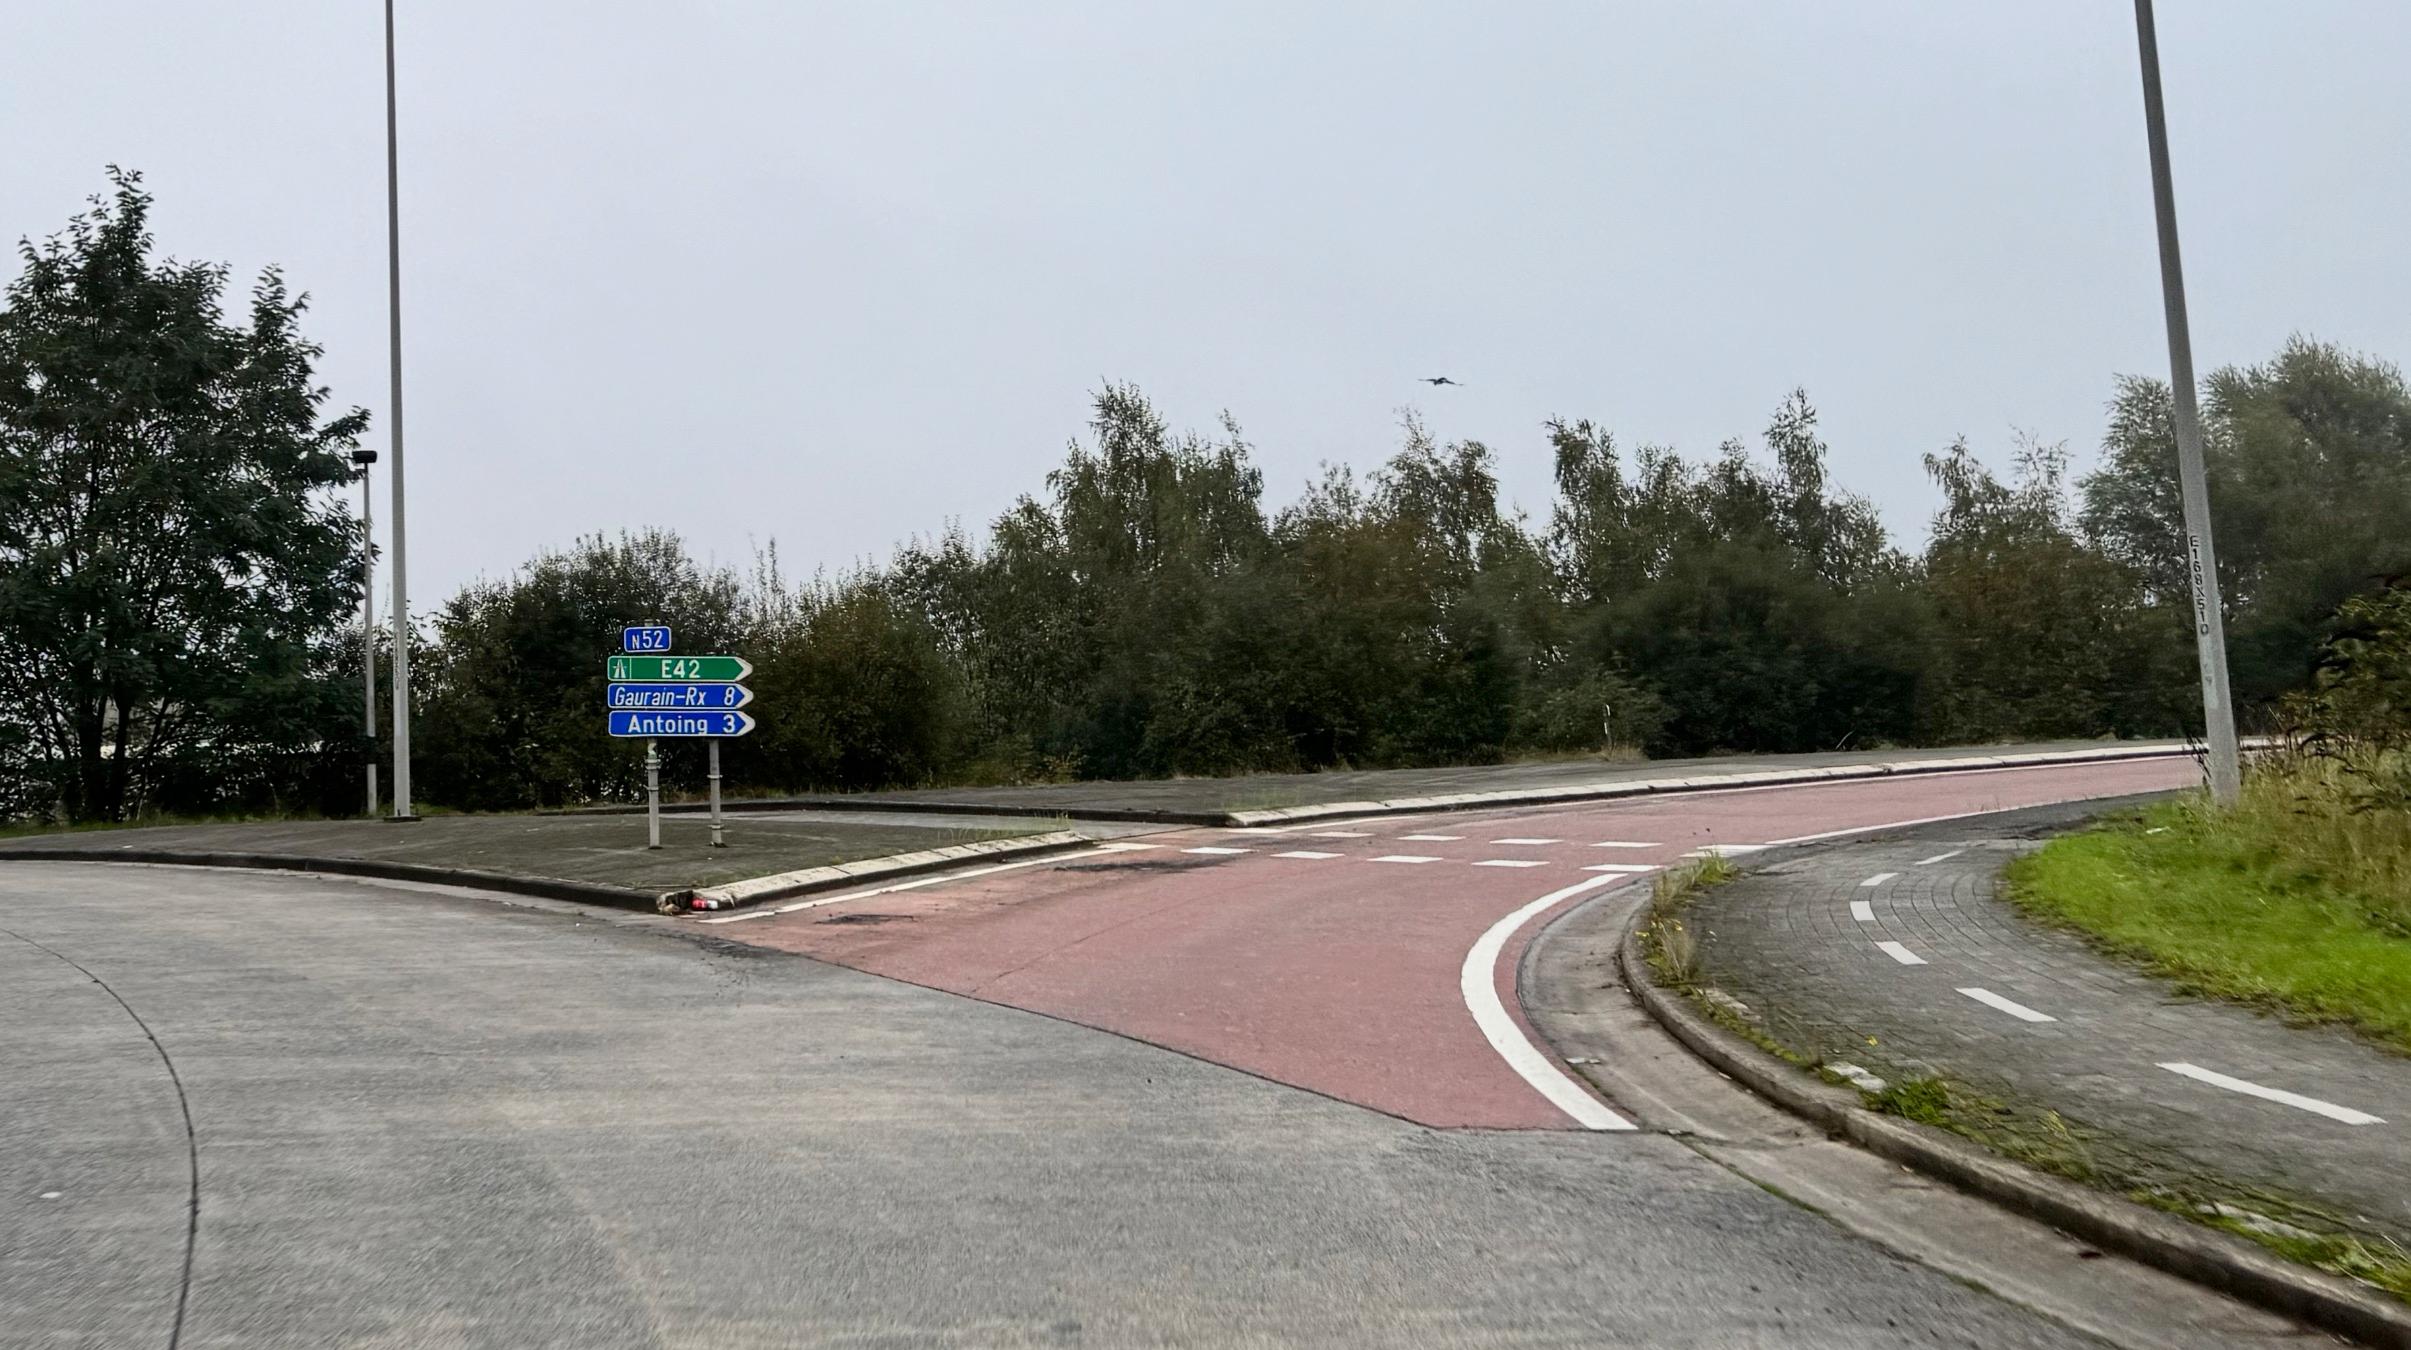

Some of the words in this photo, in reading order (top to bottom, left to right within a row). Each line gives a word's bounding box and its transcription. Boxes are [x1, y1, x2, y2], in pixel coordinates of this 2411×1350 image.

[632, 630, 664, 650] N52
[661, 659, 701, 679] E42
[614, 686, 707, 706] Gaurain-Rx
[723, 686, 736, 706] 8
[627, 714, 708, 734] Antoing
[722, 714, 736, 733] 3
